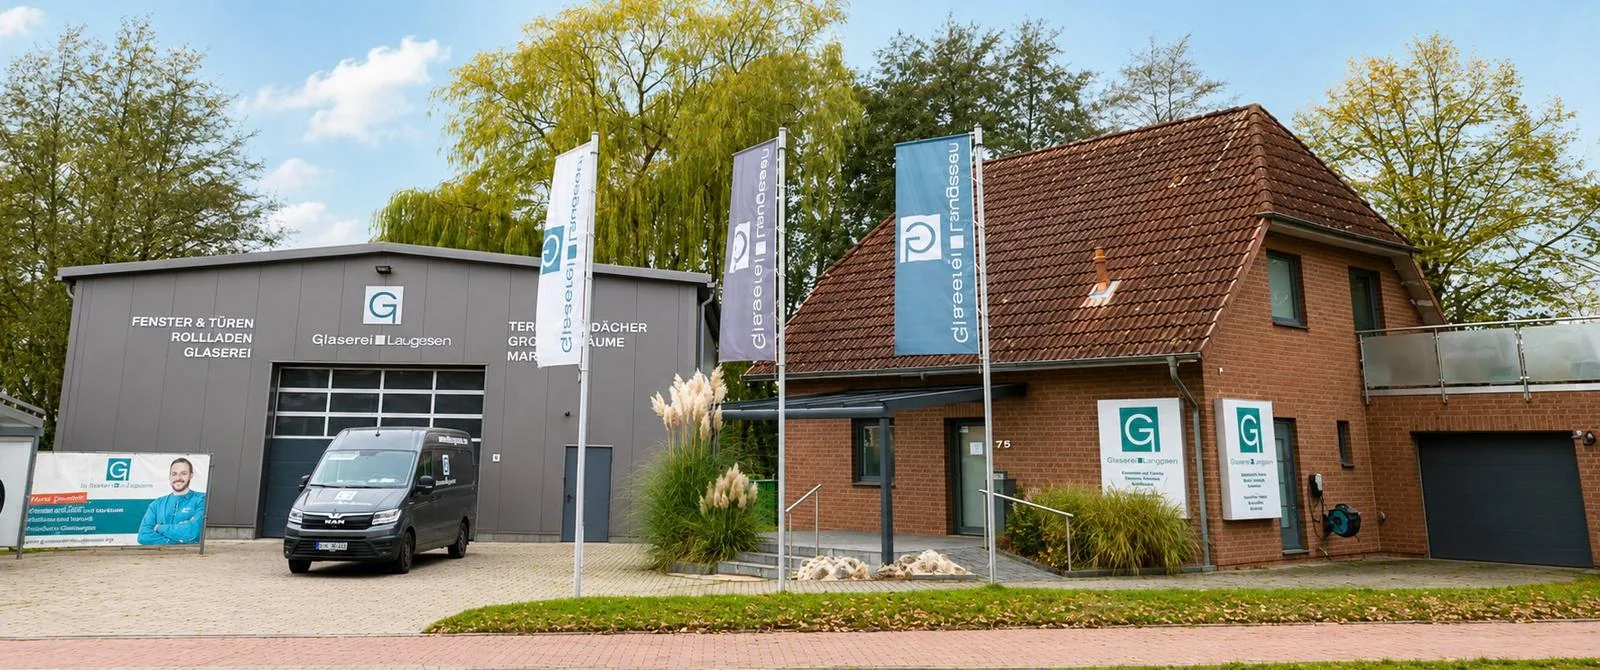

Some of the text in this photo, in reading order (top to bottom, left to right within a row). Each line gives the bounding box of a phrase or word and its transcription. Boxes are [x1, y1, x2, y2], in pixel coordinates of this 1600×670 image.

[132, 315, 254, 328] FENSTER & TÜREN
[171, 332, 253, 343] ROLLLADEN
[312, 333, 452, 349] Glaserei Laugesen
[184, 346, 251, 358] GLASEREI
[995, 440, 1011, 448] 75
